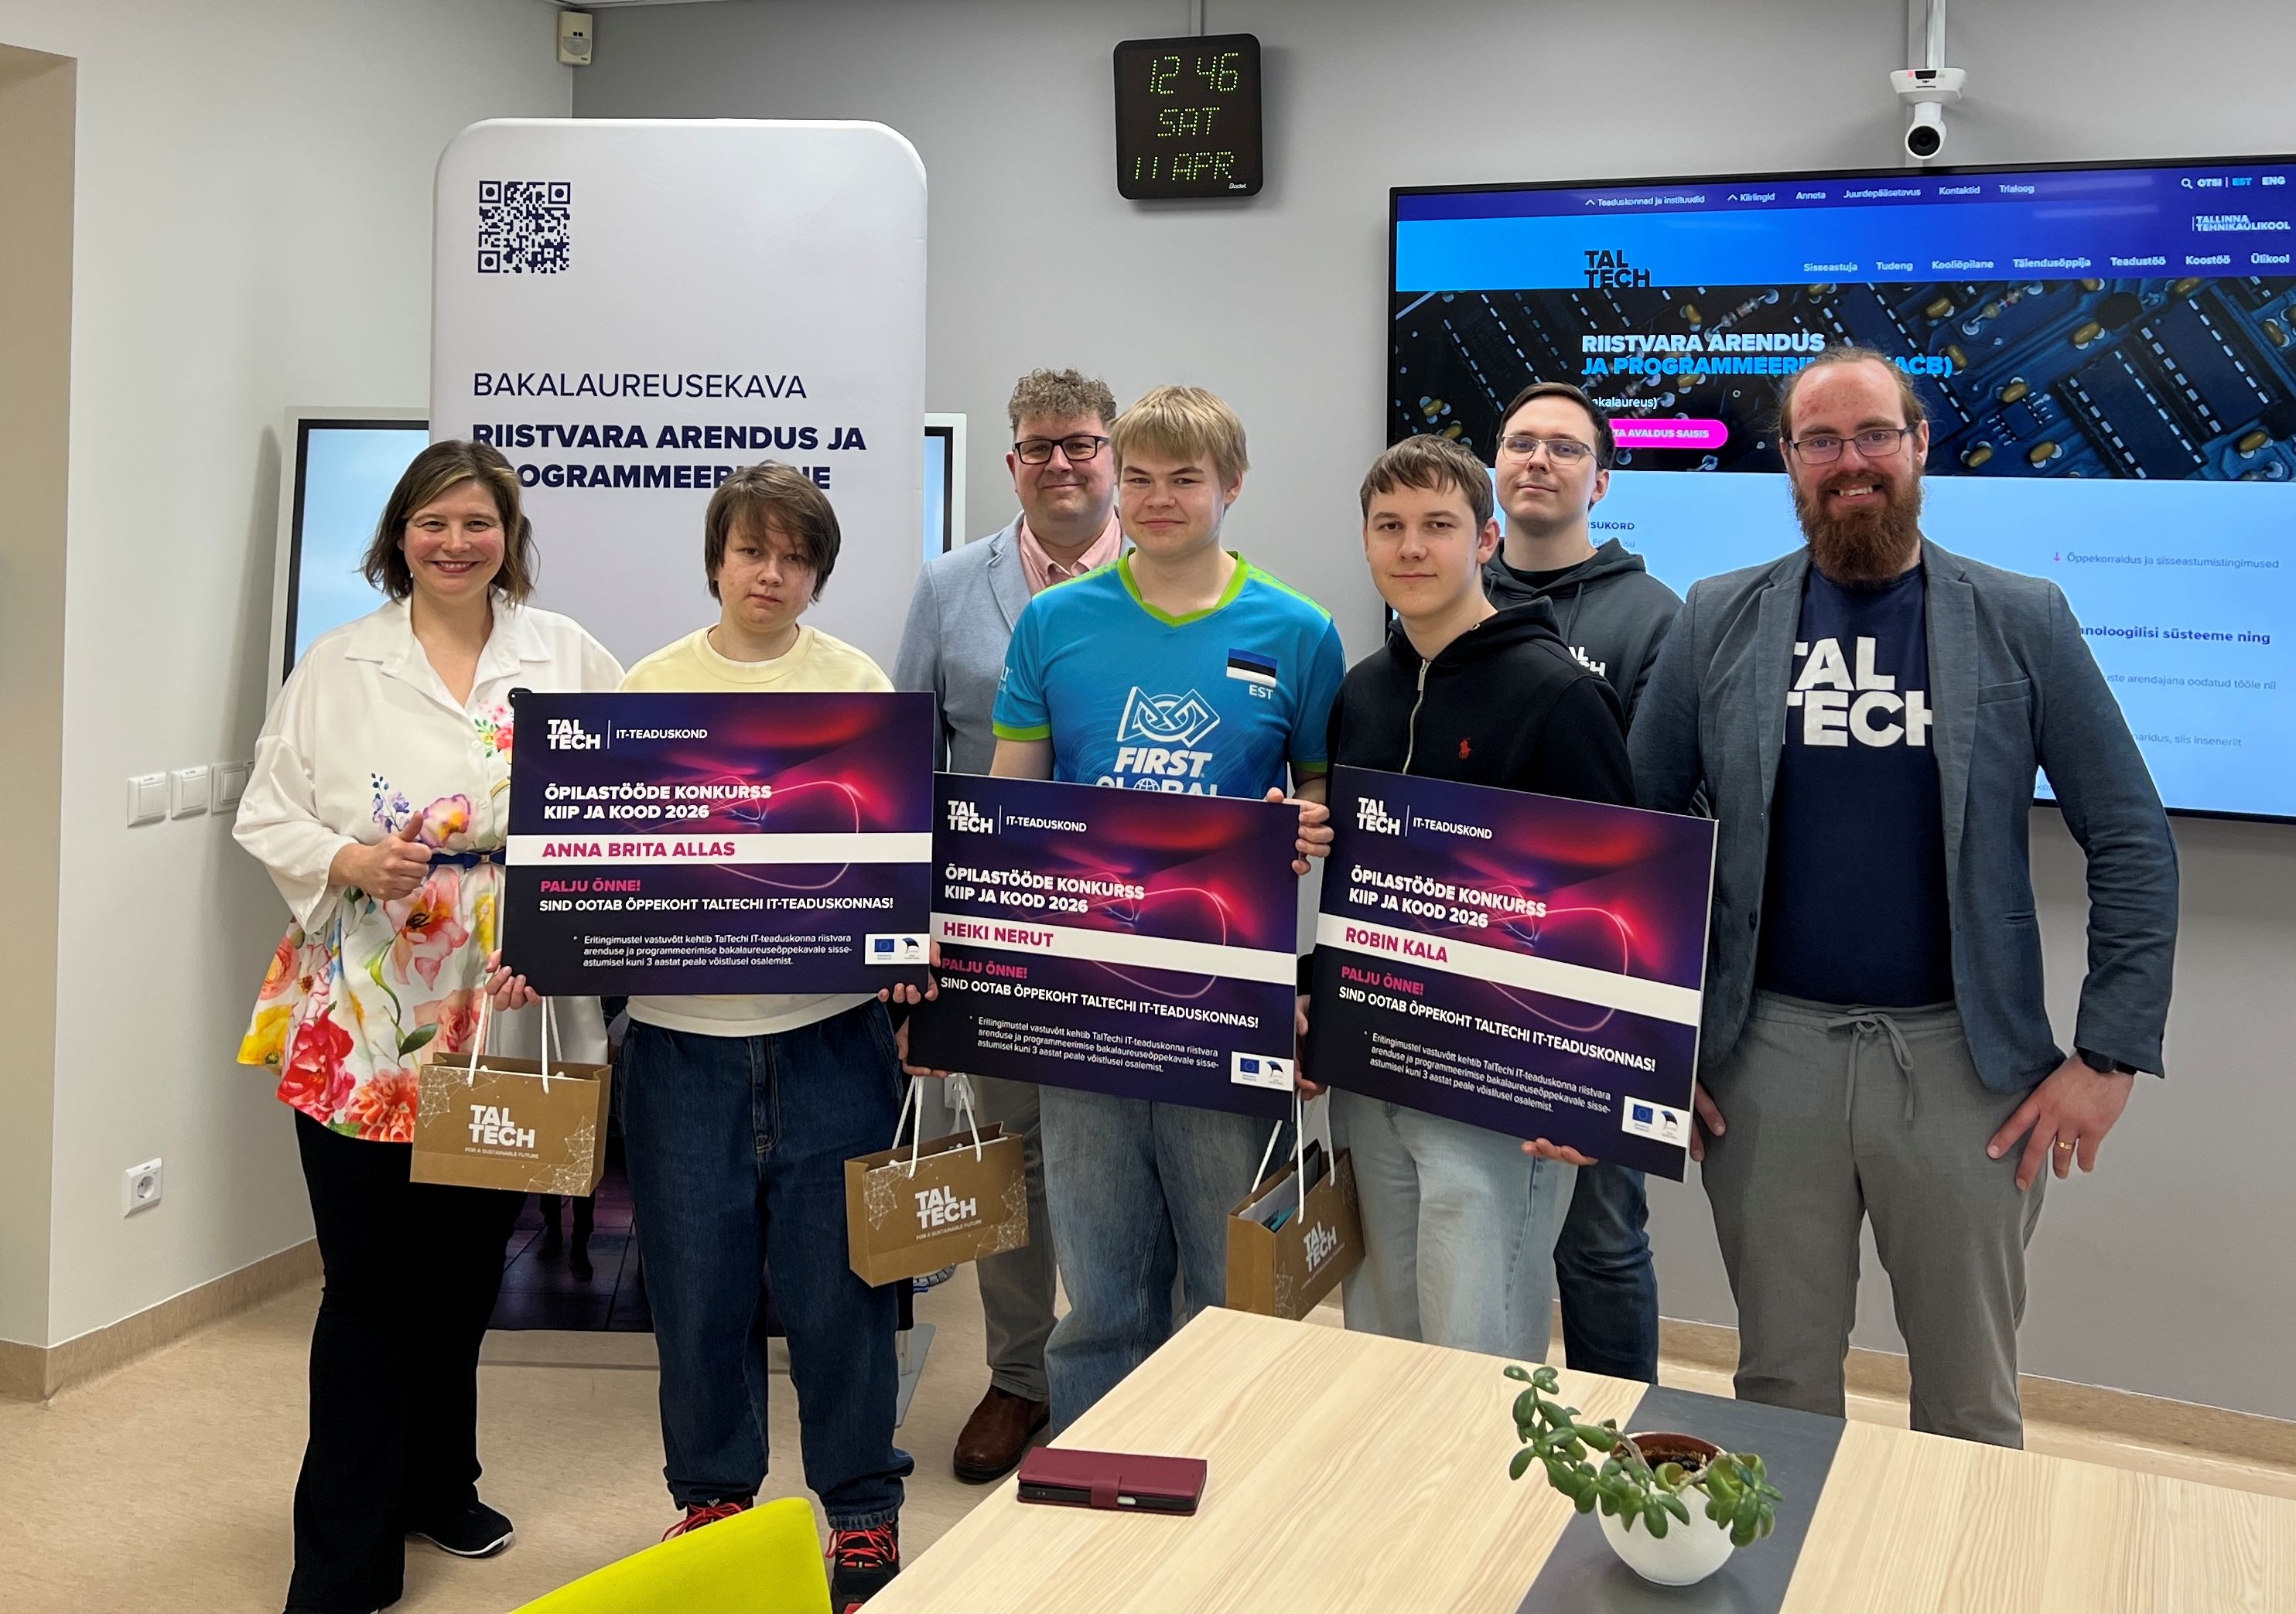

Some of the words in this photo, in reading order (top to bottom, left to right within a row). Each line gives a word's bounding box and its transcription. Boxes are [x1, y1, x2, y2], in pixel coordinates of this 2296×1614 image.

[1150, 56, 1180, 94] 12
[1197, 53, 1239, 92] 46
[1157, 107, 1220, 136] SAT
[1135, 156, 1158, 179] 11
[1172, 152, 1234, 181] APR
[1999, 184, 2035, 195] Trialoog
[2197, 178, 2223, 187] OTSI
[2232, 177, 2252, 186] EST
[2262, 176, 2286, 186] ENG
[1795, 190, 1826, 200] Anneta
[1939, 185, 1980, 196] Kontaktid
[1655, 196, 1662, 206] ja
[2195, 214, 2250, 223] TALLINNA
[1584, 249, 1629, 268] TAL
[1803, 262, 1858, 272] Sisseastuja
[1875, 261, 1914, 271] Tudeng
[2110, 256, 2166, 267] Teadustöö
[2185, 254, 2231, 265] Koostöö
[2250, 252, 2290, 264] Ülikool
[1584, 268, 1651, 288] TECH
[1582, 334, 1703, 353] RIISTVARA
[1707, 333, 1826, 352] ARENDUS
[1580, 357, 1608, 375] JA
[473, 373, 807, 399] BAKALAUREUSEKAVA
[473, 424, 647, 449] RIISTVARA
[656, 425, 818, 450] ARENDUS
[827, 427, 867, 450] JA
[1627, 428, 1675, 438] AVALDUS
[1676, 429, 1710, 438] SAISIS
[1588, 521, 1635, 530] SUKORD
[2144, 554, 2154, 566] ja
[2156, 556, 2279, 569] sisseastumistingimused
[2163, 628, 2233, 641] süsteeme
[2237, 630, 2270, 645] ning
[2127, 674, 2185, 686] arendajana
[2188, 677, 2231, 688] oodatud
[1249, 684, 1275, 701] EST
[548, 719, 583, 734] TAL
[616, 729, 707, 739] IT-TEADUSKOND
[547, 735, 600, 749] TECH
[1113, 746, 1213, 778] FIRST
[545, 782, 670, 800] ÕPILASTÖÖDE
[675, 785, 772, 800] KONKURSS
[544, 805, 579, 818] KIIP
[583, 805, 605, 819] JA
[609, 805, 661, 818] KOOD
[665, 804, 709, 818] 2026
[948, 800, 979, 817] TAL
[1358, 797, 1386, 817] TAL
[947, 815, 993, 834] TECH
[1006, 816, 1086, 831] IT-TEADUSKOND
[1356, 813, 1400, 835] TECH
[1413, 817, 1491, 838] IT-TEADUSKOND
[542, 843, 602, 857] ANNA
[608, 842, 667, 856] BRITA
[671, 841, 734, 856] ALLAS
[541, 880, 588, 892] PALJU
[592, 877, 641, 891] ÕNNE!
[945, 863, 1053, 889] ÕPILASTÖÖDE
[1057, 877, 1145, 900] KONKURSS
[945, 885, 975, 899] KIIP
[977, 889, 996, 903] JA
[999, 890, 1045, 907] KOOD
[1048, 896, 1088, 913] 2026
[1351, 864, 1455, 900] ÕPILASTÖÖDE
[1458, 886, 1546, 918] KONKURSS
[539, 899, 572, 911] SIND
[576, 899, 622, 910] OOTAB
[625, 896, 699, 910] ÕPPEKOHT
[702, 899, 763, 909] TALTECHI
[767, 897, 893, 909] IT-TEADUSKONNAS!
[1348, 887, 1378, 905] KIIP
[1380, 894, 1399, 910] JA
[1402, 897, 1446, 919] KOOD
[1449, 907, 1488, 928] 2026
[584, 935, 642, 945] Eritingimustel
[644, 935, 683, 943] vastuvõtt
[685, 934, 712, 943] kehtib
[714, 934, 748, 943] TalTechi
[750, 933, 815, 942] IT-teaduskonna
[943, 921, 988, 940] HEIKI
[994, 927, 1053, 947] NERUT
[1345, 927, 1398, 951] ROBIN
[1403, 939, 1447, 962] KALA
[942, 959, 982, 973] PALJU
[986, 961, 1027, 978] ÕNNE!
[1341, 966, 1380, 985] PALJU
[1383, 972, 1423, 995] ÕNNE!
[941, 977, 968, 989] SIND
[971, 981, 1011, 995] OOTAB
[1013, 983, 1078, 1004] ÕPPEKOHT
[1081, 994, 1136, 1012] TALTECHI
[1139, 1001, 1258, 1028] IT-TEADUSKONNAS!
[978, 1016, 1028, 1030] Eritingimustel
[1030, 1025, 1064, 1036] vastuvõtt
[1066, 1028, 1090, 1039] kehtib
[1092, 1031, 1122, 1043] TalTechi
[1125, 1036, 1184, 1052] IT-teaduskonna
[1187, 1046, 1218, 1056] riistvara
[1338, 986, 1365, 1001] SIND
[1368, 993, 1406, 1012] OOTAB
[1409, 1000, 1472, 1027] ÕPPEKOHT
[1474, 1018, 1530, 1042] TALTECHI
[1532, 1031, 1655, 1072] IT-TEADUSKONNAS!
[470, 1104, 514, 1127] TAL
[468, 1124, 535, 1148] TECH
[914, 1185, 957, 1211] TAL
[916, 1198, 977, 1230] TECH
[1303, 1220, 1325, 1253] TAL
[1306, 1225, 1337, 1273] TECH
